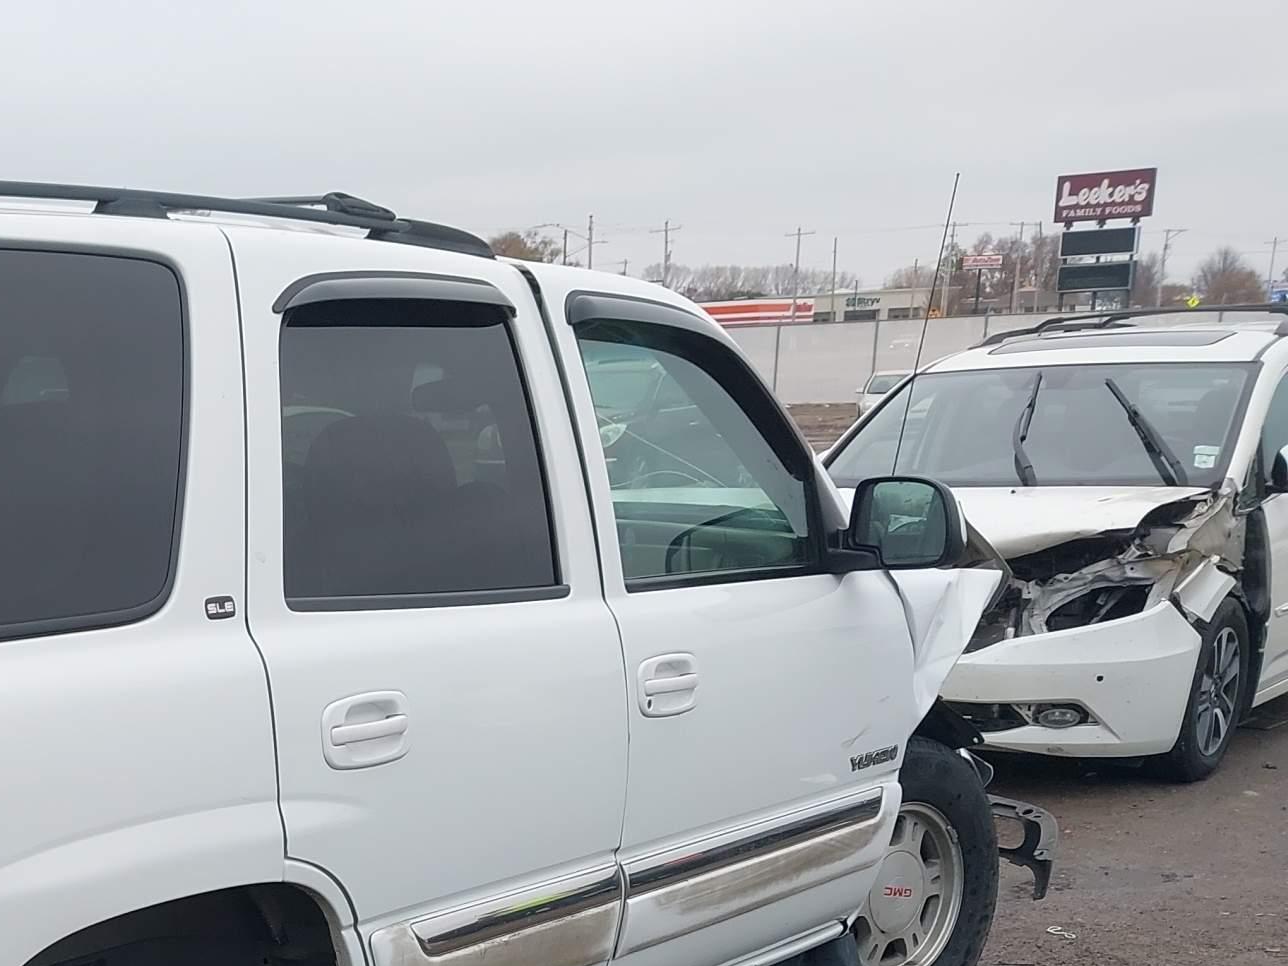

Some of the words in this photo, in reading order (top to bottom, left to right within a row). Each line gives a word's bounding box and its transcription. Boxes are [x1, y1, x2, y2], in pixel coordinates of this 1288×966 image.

[1058, 178, 1150, 207] Leeker's
[1062, 207, 1102, 217] FAMILY
[1105, 204, 1142, 215] FOODS
[207, 601, 234, 614] SLE
[883, 886, 912, 898] GMC
